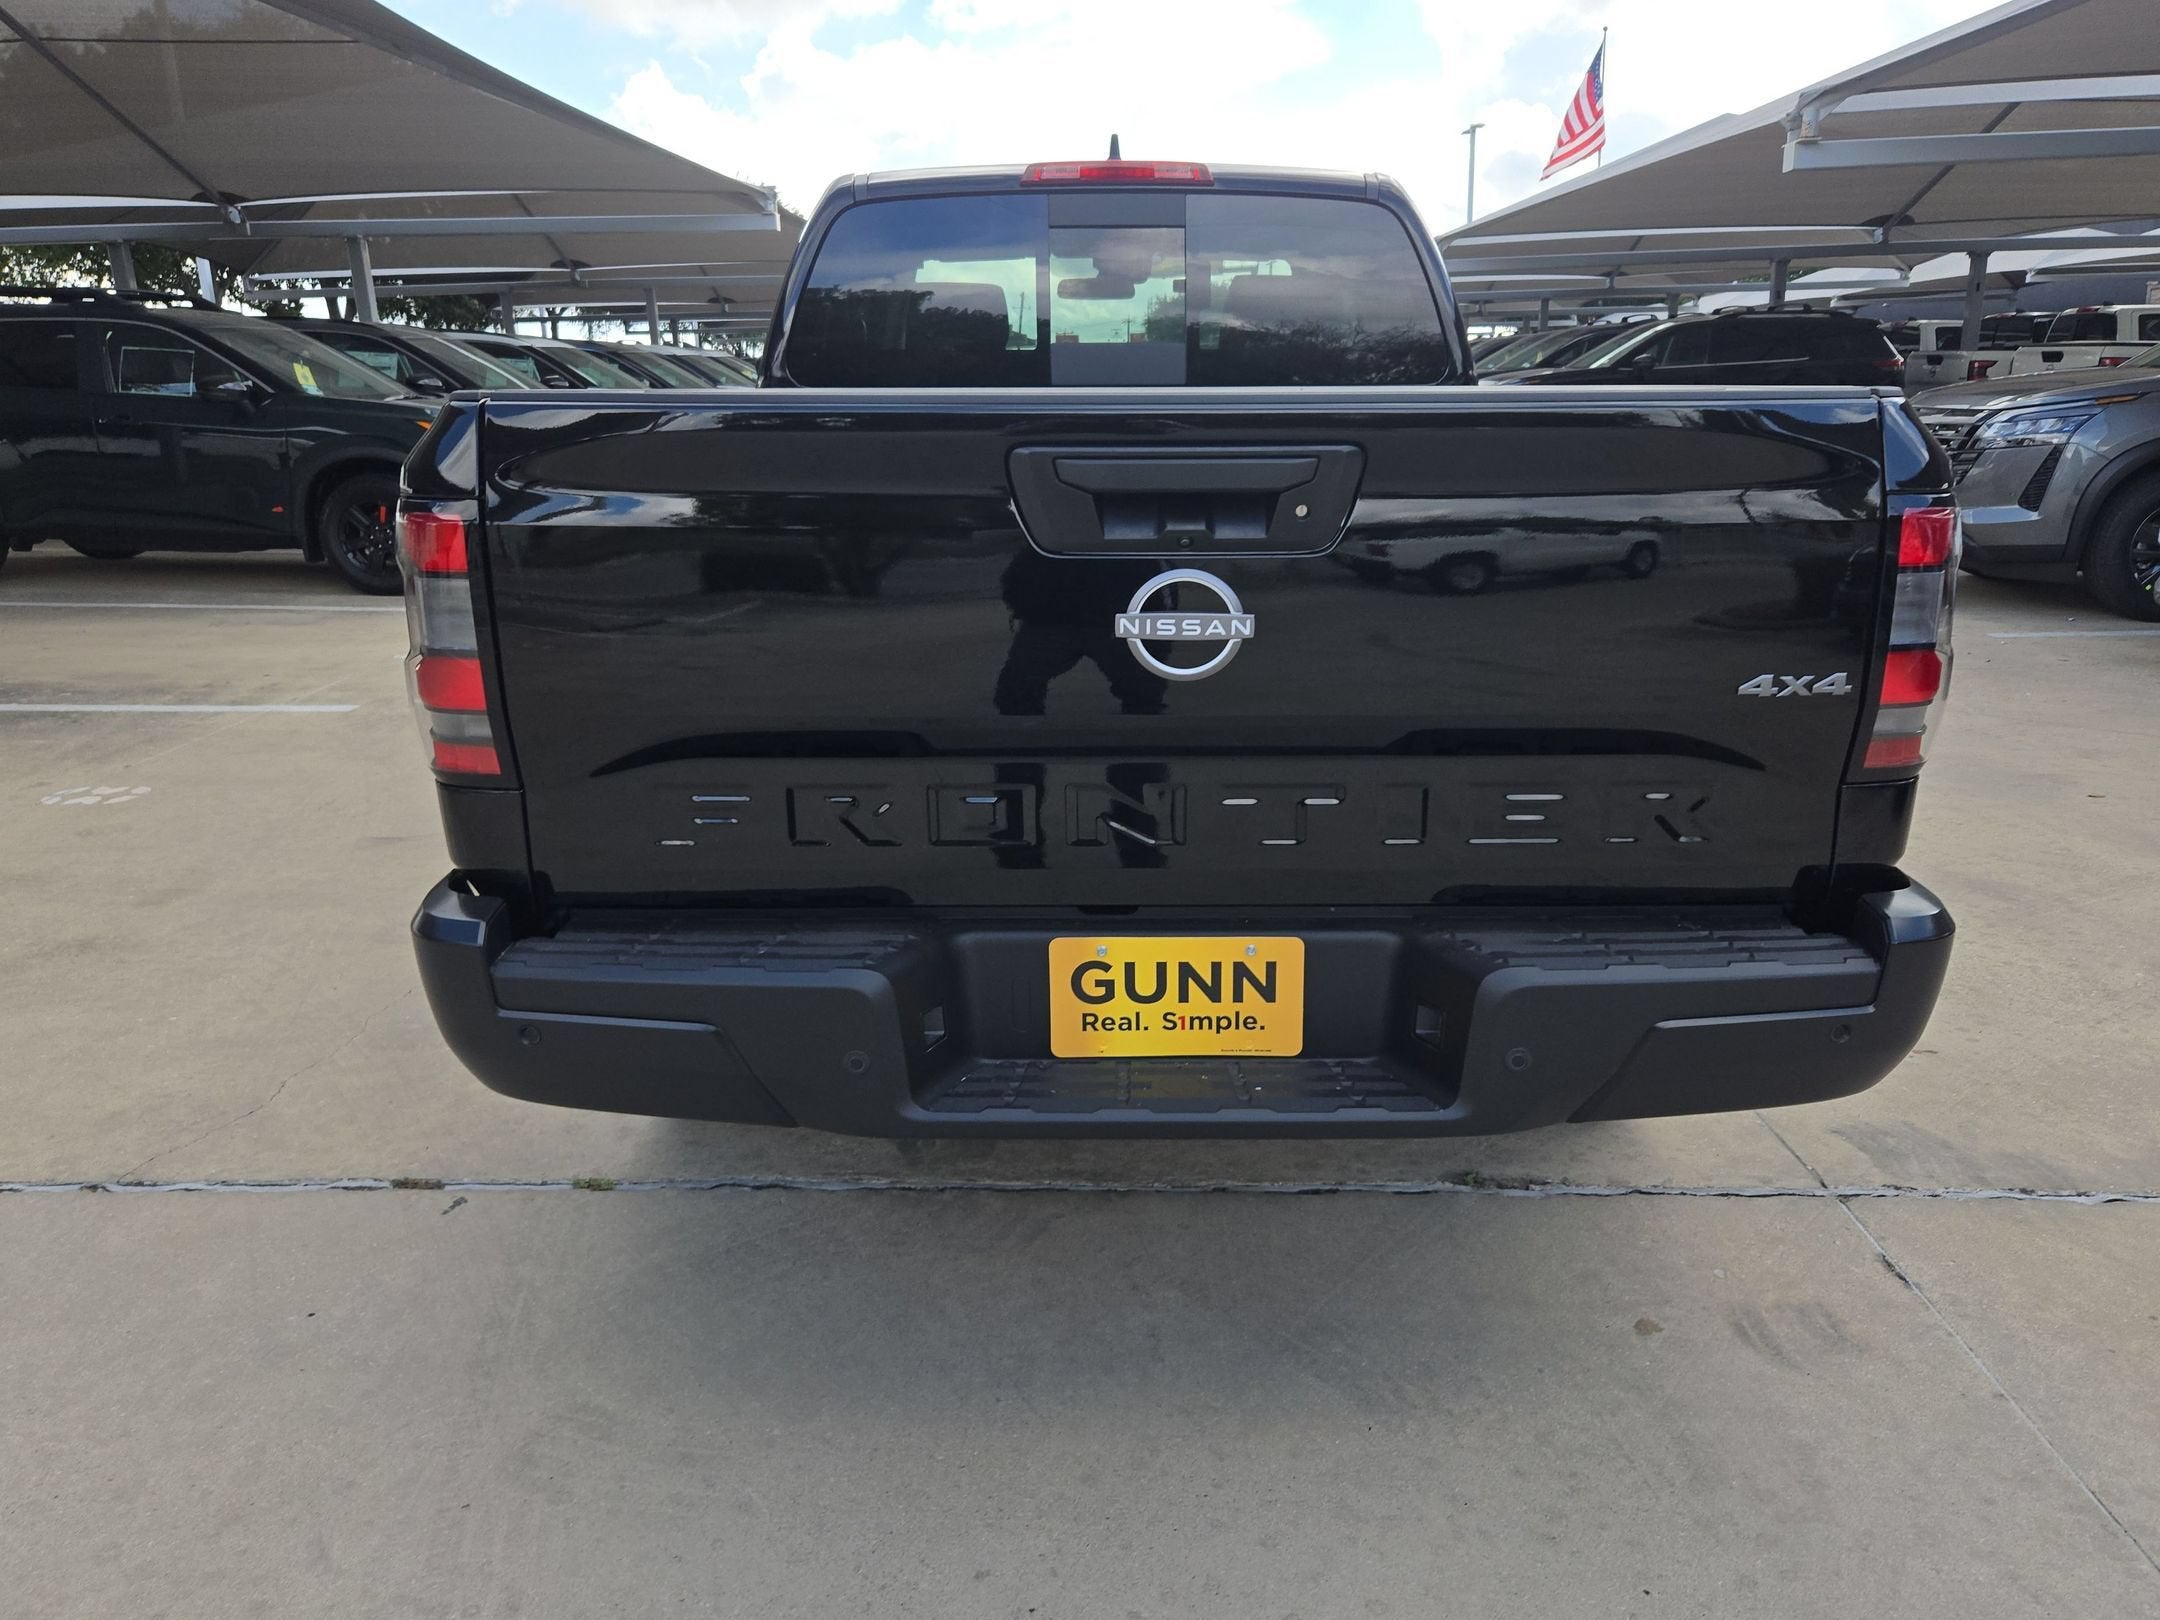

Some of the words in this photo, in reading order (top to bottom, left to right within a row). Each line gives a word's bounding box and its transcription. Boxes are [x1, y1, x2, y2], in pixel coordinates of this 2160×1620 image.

[1118, 617, 1251, 637] NISSAN
[654, 782, 1711, 848] FRONTIER
[1070, 959, 1277, 1005] GUNN
[1081, 1011, 1149, 1032] Real.
